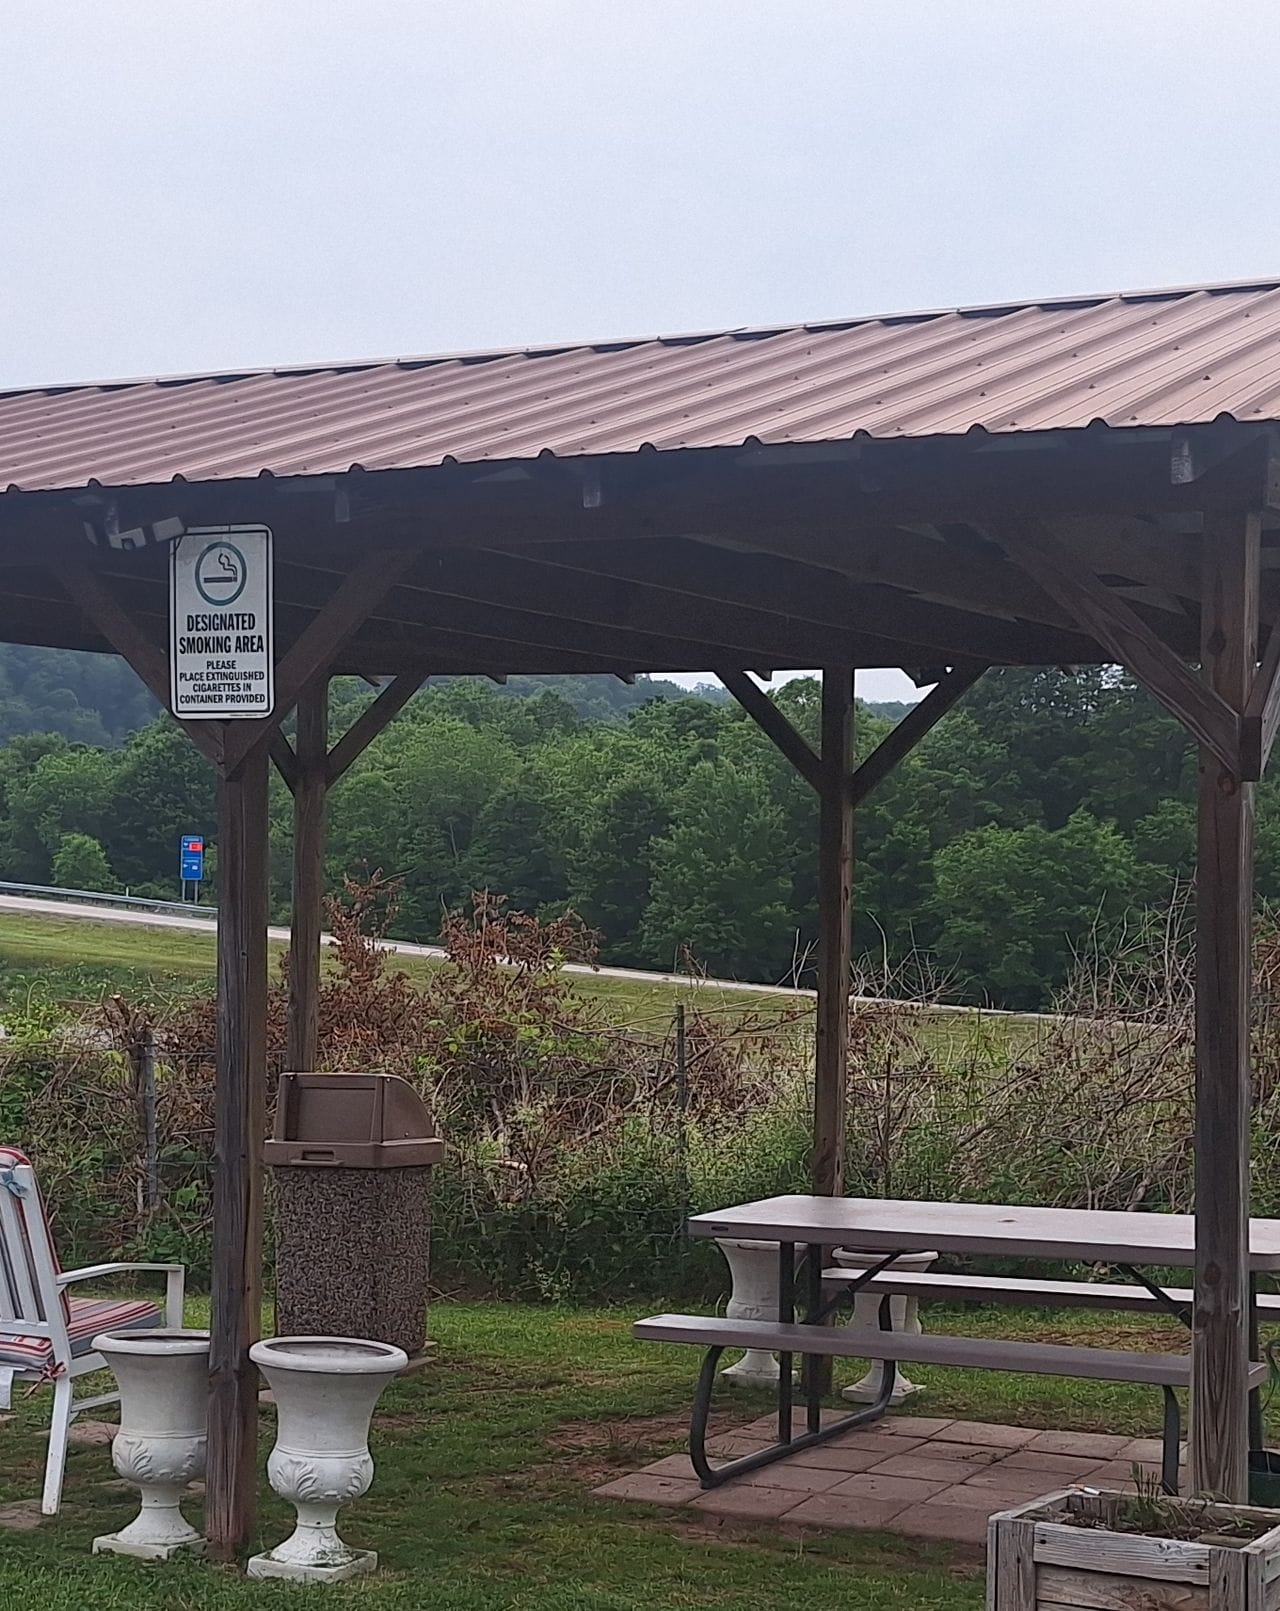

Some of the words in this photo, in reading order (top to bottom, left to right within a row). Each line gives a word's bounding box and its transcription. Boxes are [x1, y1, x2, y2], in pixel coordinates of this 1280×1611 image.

[187, 613, 255, 632] DESIGNATED
[179, 635, 231, 654] SMOKING
[235, 635, 264, 653] AREA
[206, 660, 237, 669] PLEASE
[179, 672, 204, 681] PLACE
[206, 671, 265, 680] EXTINGUISHED
[193, 683, 241, 692] CIGARETTES
[243, 683, 252, 692] IN
[179, 695, 223, 704] CONTAINER
[225, 694, 265, 703] PROVIDED
